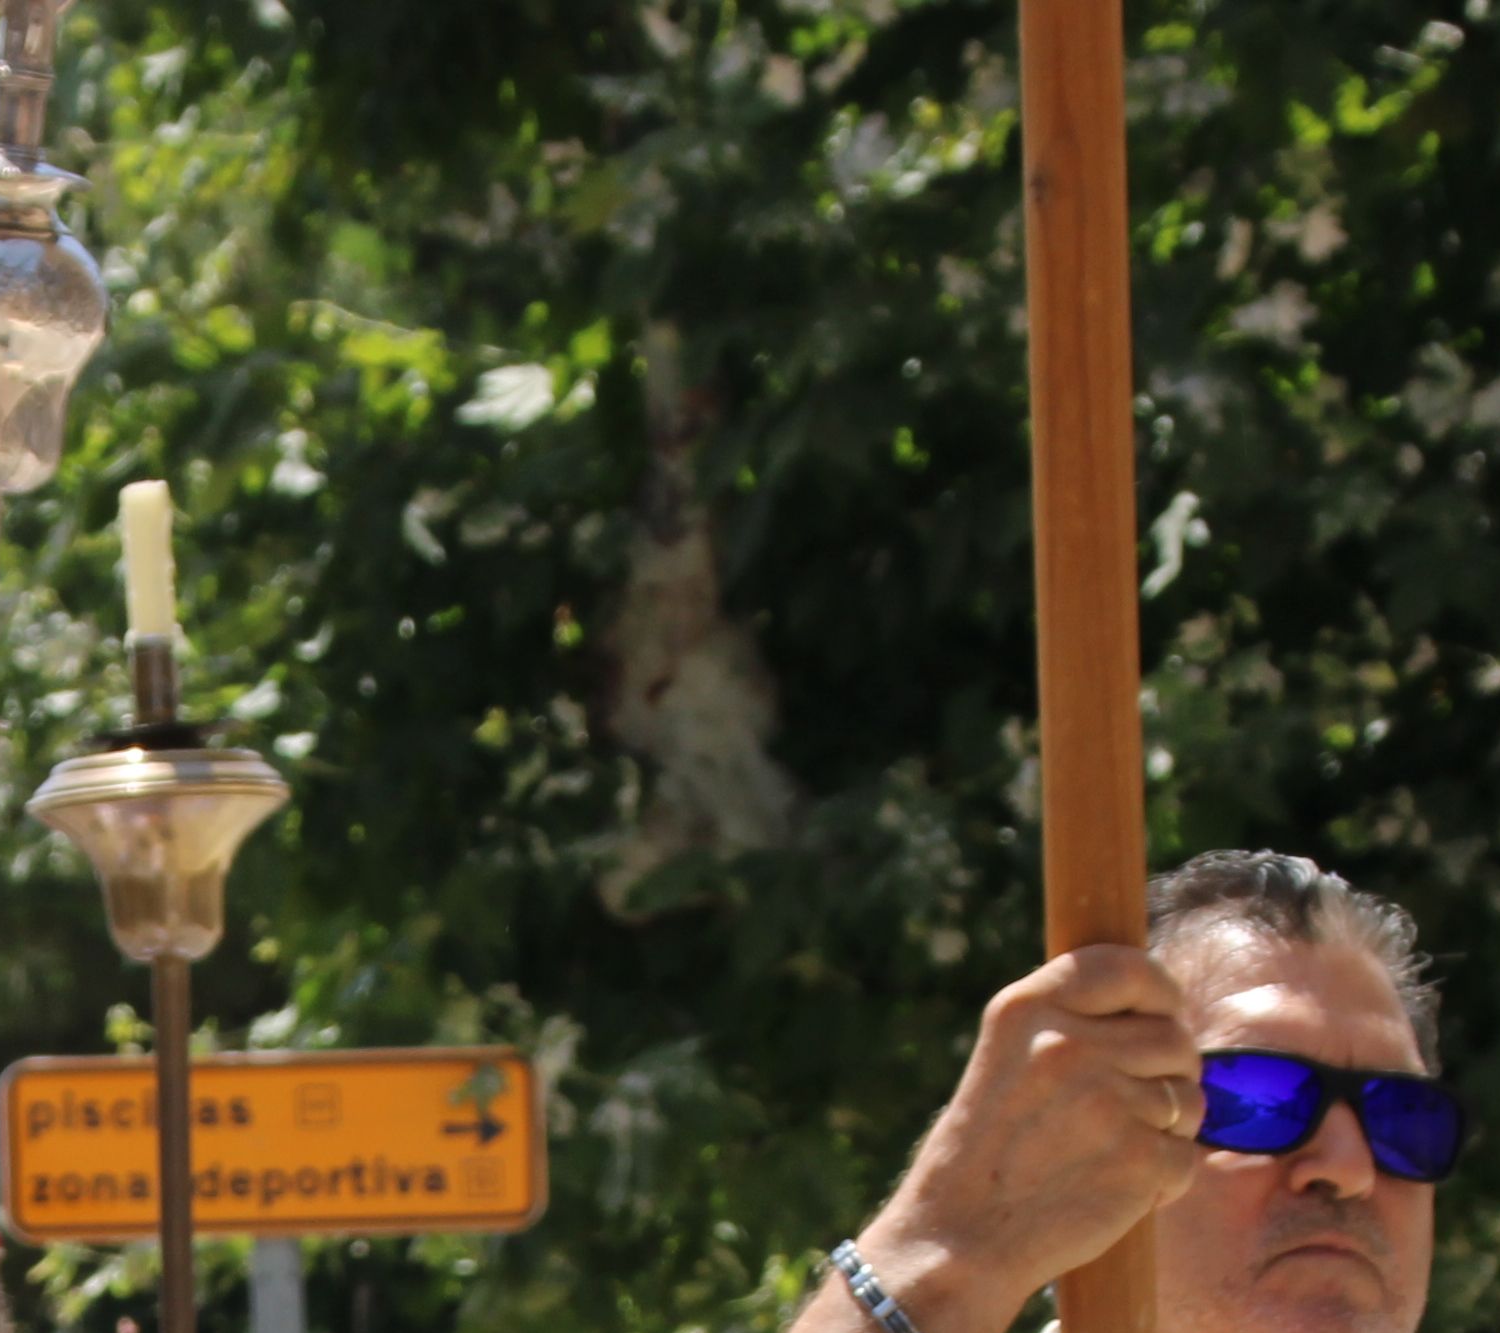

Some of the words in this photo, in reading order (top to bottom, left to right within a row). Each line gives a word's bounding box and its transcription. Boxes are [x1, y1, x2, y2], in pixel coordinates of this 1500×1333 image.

[28, 1088, 253, 1141] piscias
[33, 1173, 150, 1206] zona
[188, 1156, 447, 1207] deportiva
